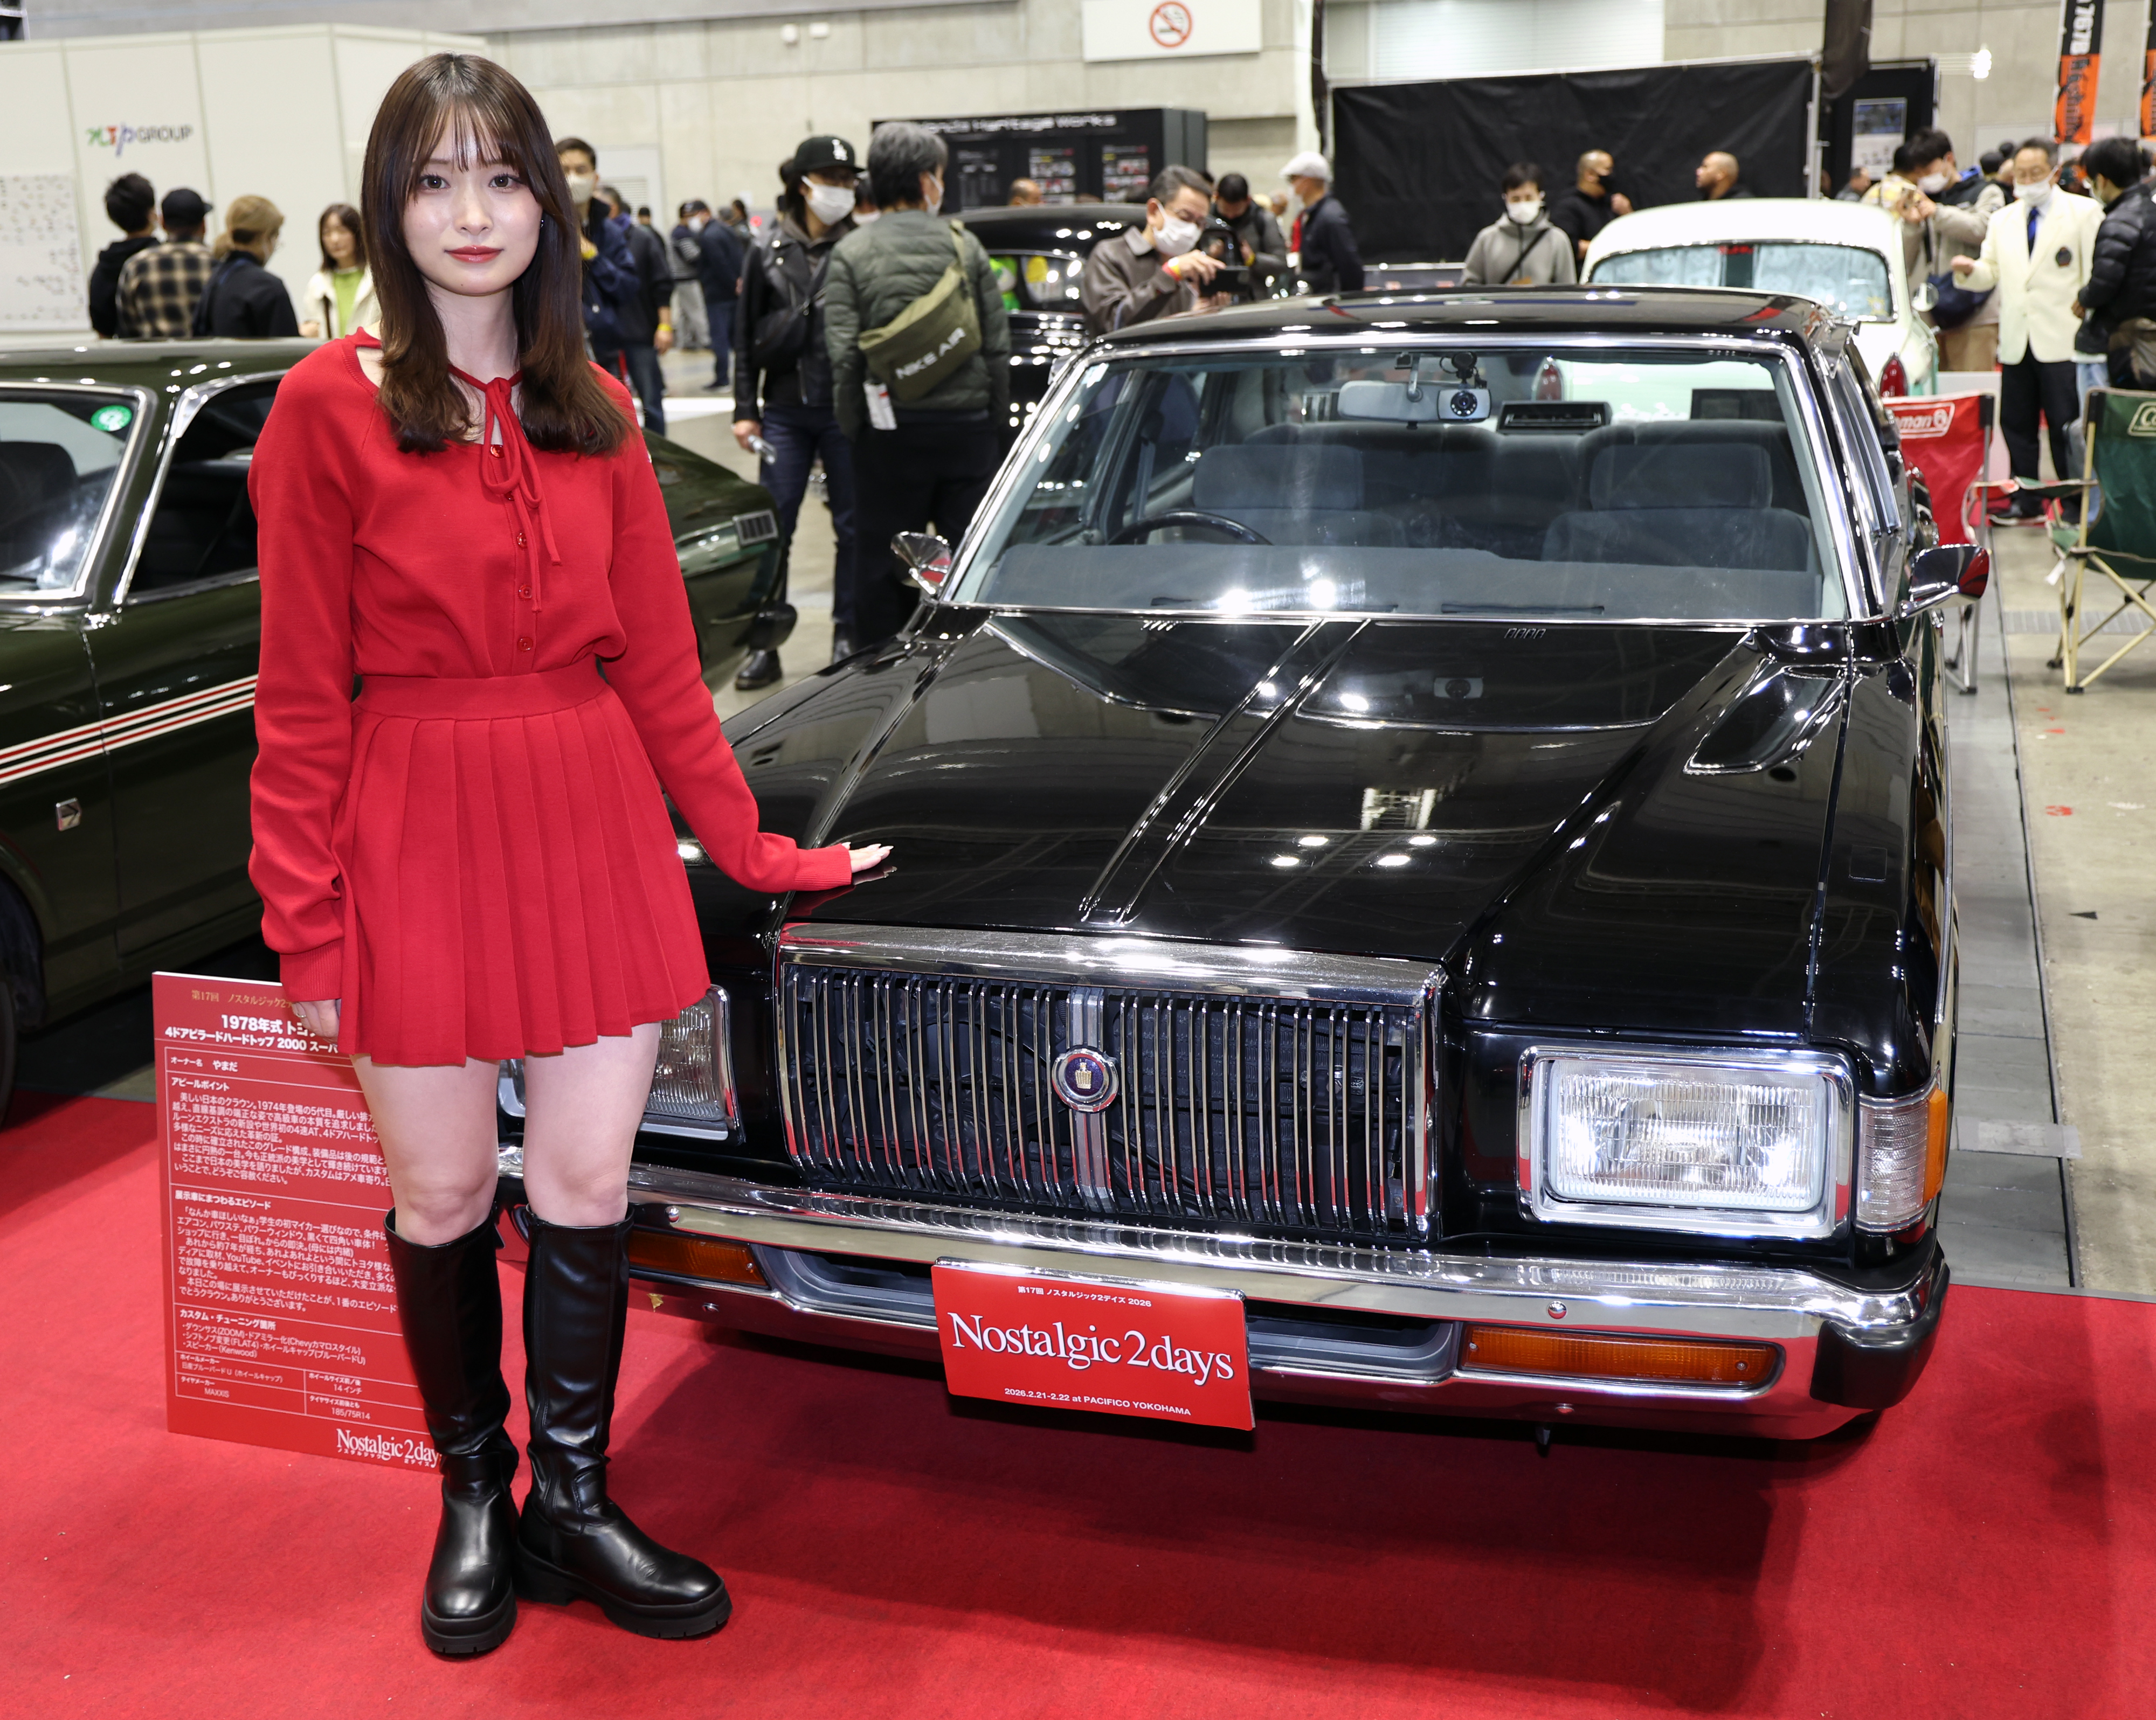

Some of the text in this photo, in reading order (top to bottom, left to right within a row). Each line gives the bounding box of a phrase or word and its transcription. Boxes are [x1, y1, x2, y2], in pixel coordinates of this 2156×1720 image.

[137, 124, 194, 143] GROUP
[895, 327, 966, 379] NIKE AIR
[192, 989, 219, 1002] 第17回
[221, 1014, 316, 1037] 1978年式 トヨ
[277, 1037, 307, 1051] 2000
[170, 1056, 238, 1072] オーナー名 やまだ
[171, 1077, 230, 1092] アピールポイント
[175, 1189, 272, 1210] 展示車にまつわるエピソード
[178, 1266, 218, 1280] なりました。
[1018, 1286, 1152, 1307] 第17回 ノスタルジック2デイズ 2026
[946, 1312, 1234, 1386] Nostalgic 2days
[204, 1388, 230, 1398] MAXXIS
[1004, 1388, 1192, 1416] 2026.2.21-2.22 at PACIFICO YOKOHAMA
[331, 1407, 371, 1420] 185/75R14
[336, 1428, 442, 1468] Nostalgic 2day
